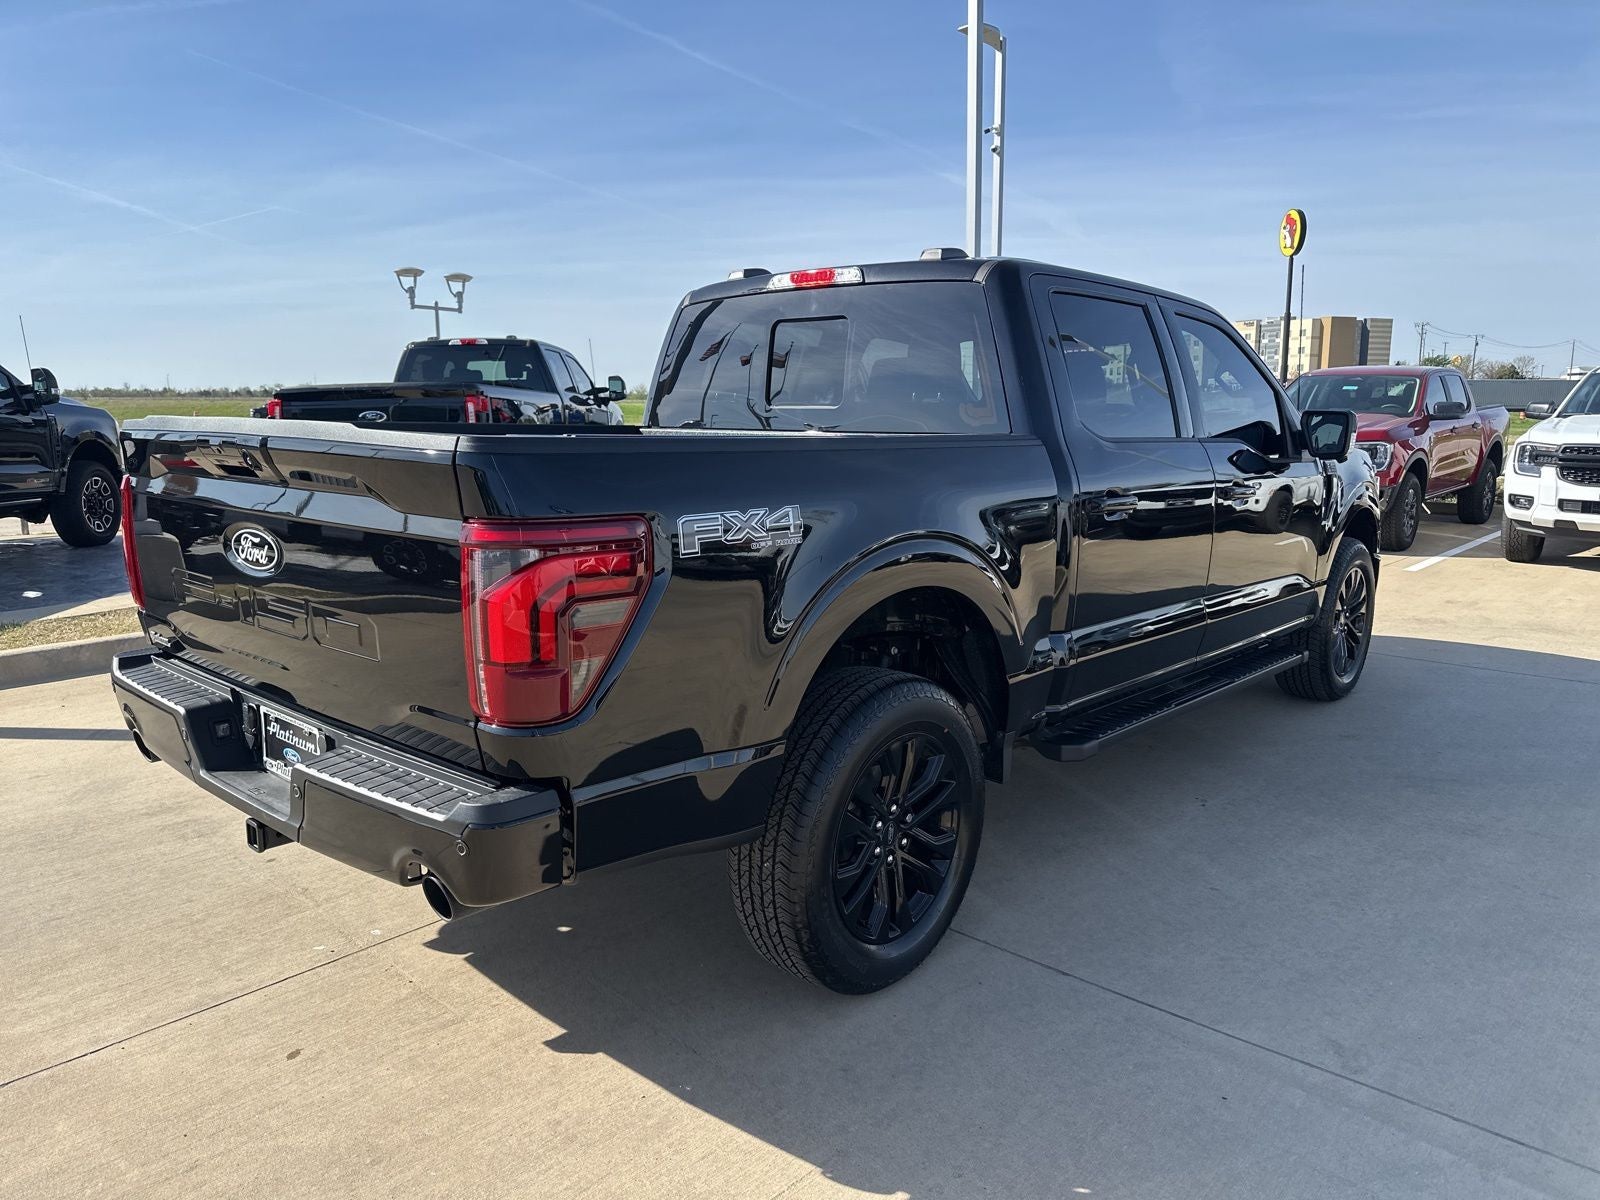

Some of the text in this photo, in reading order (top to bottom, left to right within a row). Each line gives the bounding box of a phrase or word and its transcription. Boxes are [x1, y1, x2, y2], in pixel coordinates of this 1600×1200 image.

[239, 533, 269, 565] Ford
[677, 505, 803, 558] FX4
[267, 721, 320, 756] Platinum
